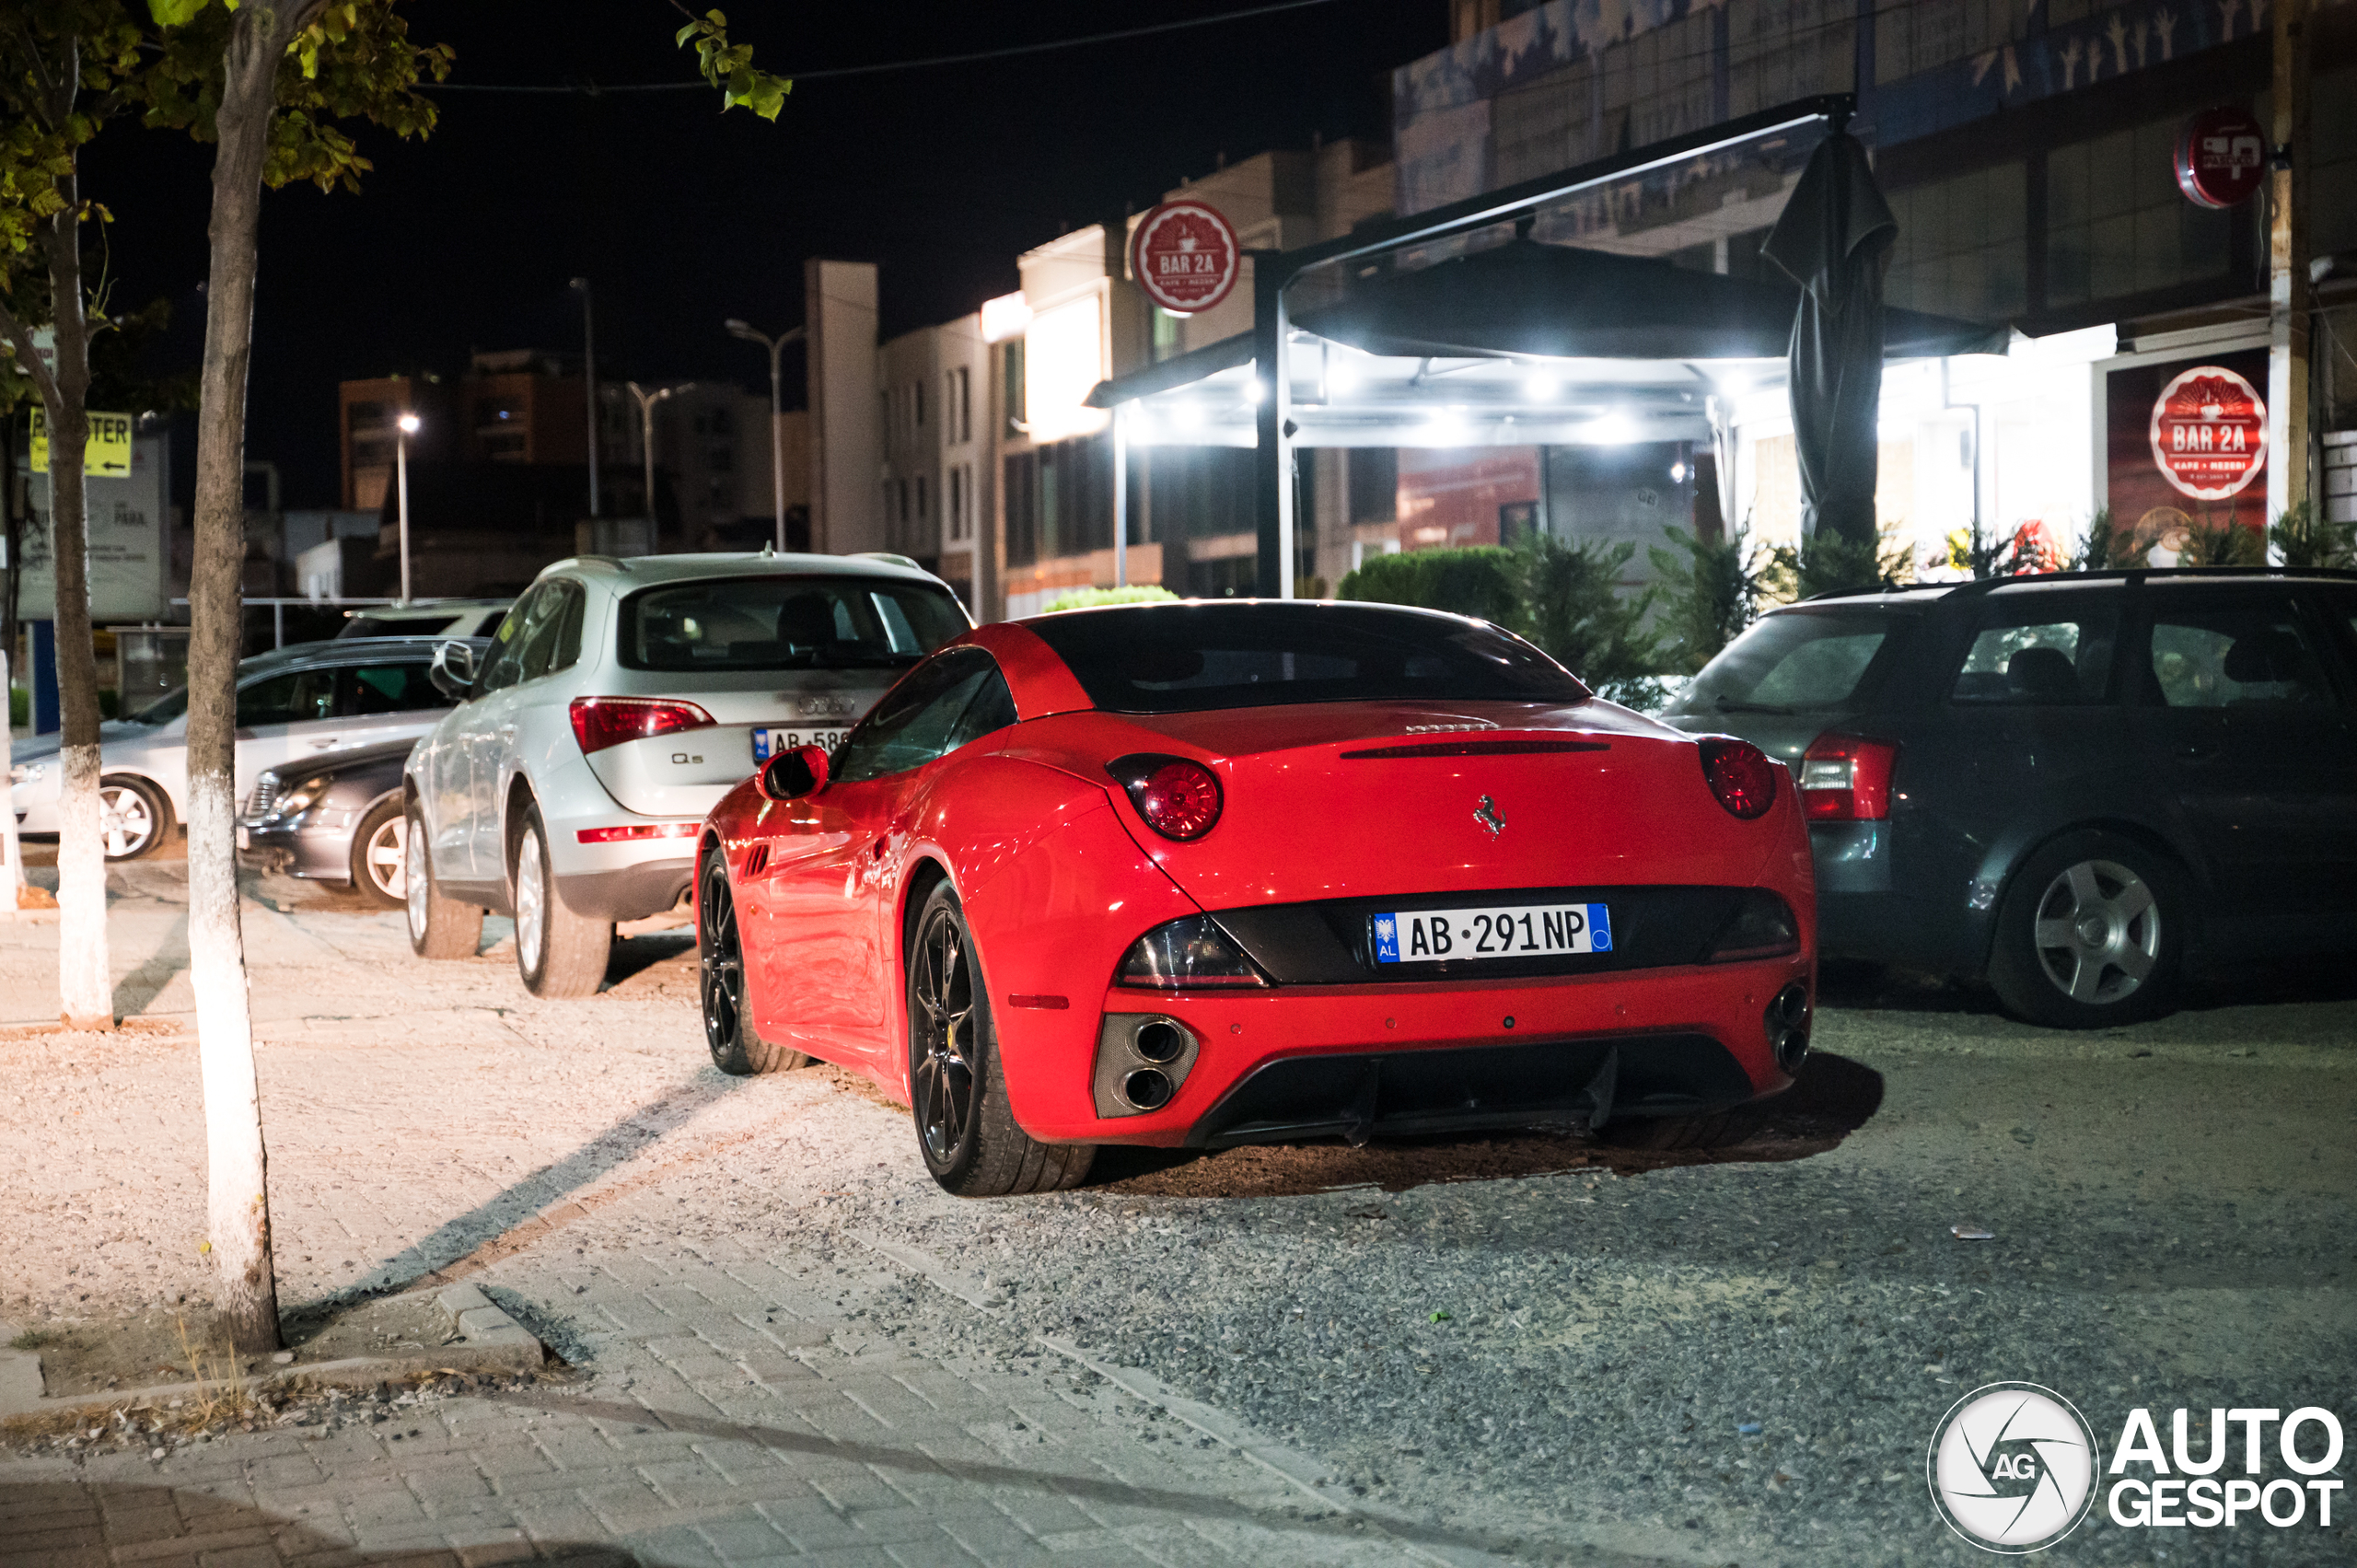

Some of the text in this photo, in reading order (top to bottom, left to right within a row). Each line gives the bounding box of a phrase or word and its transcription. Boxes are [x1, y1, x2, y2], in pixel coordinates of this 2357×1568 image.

[1160, 254, 1214, 274] BAR 2A
[2173, 424, 2246, 451] BAR 2A
[1411, 911, 1585, 956] AB 291NP
[1379, 945, 1397, 957] AL
